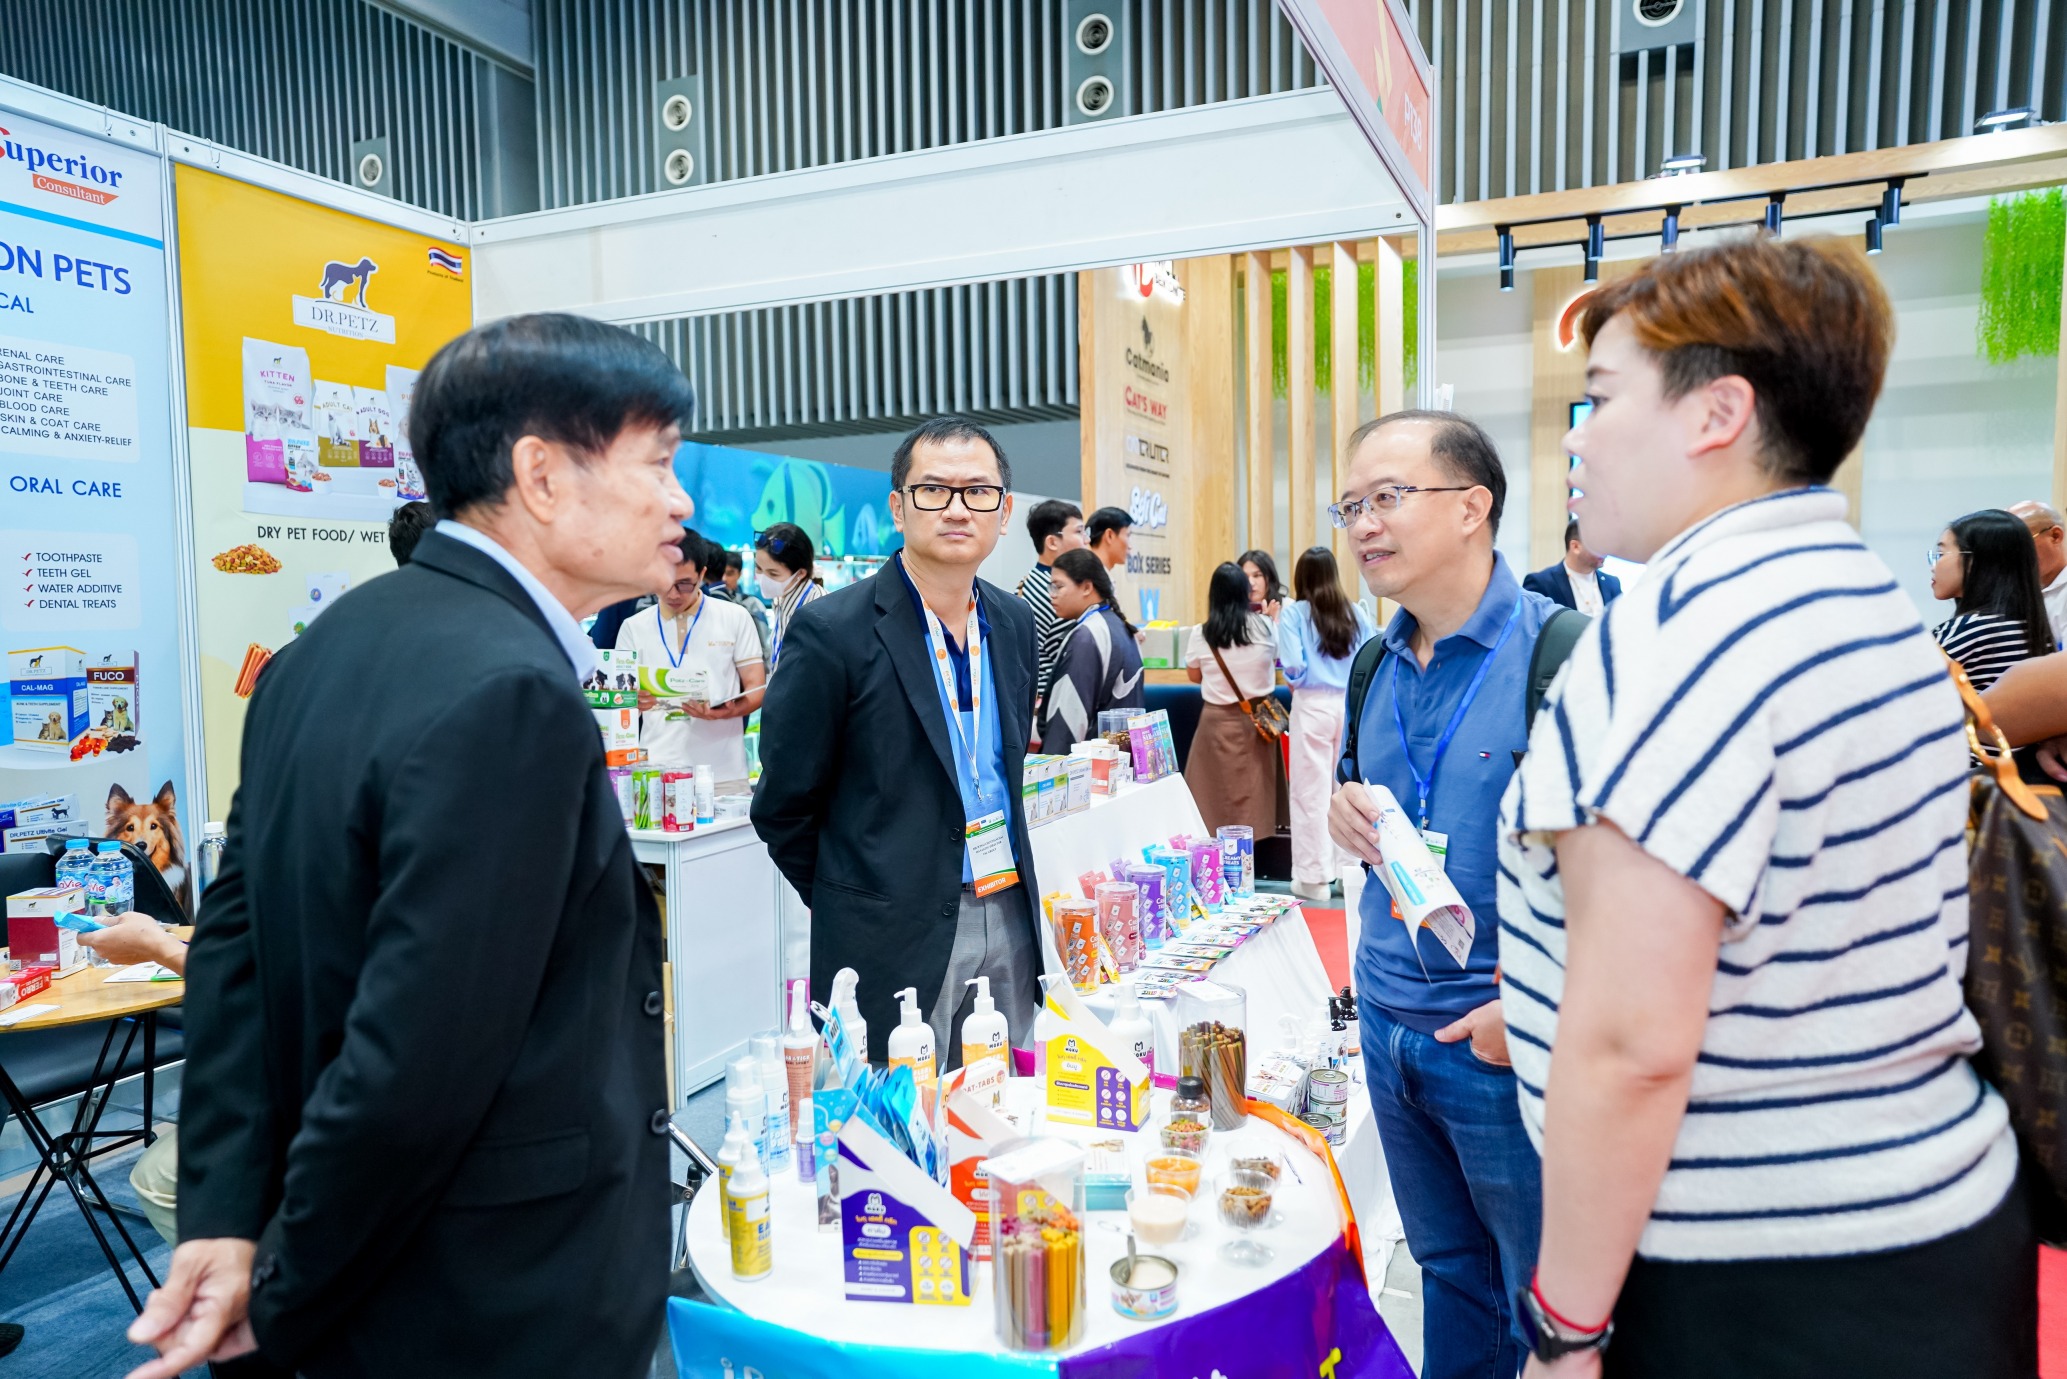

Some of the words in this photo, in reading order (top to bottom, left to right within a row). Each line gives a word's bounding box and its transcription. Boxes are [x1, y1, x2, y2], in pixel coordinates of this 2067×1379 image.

[36, 176, 106, 205] Consultant
[54, 253, 132, 295] PETS
[311, 306, 379, 334] DR.PETZ
[35, 353, 65, 365] CARE
[1126, 347, 1169, 383] Catmania
[105, 376, 132, 387] CARE
[260, 370, 295, 382] KITTEN
[32, 378, 39, 387] &
[43, 379, 77, 392] TEETH
[80, 384, 108, 396] CARE
[33, 391, 63, 402] CARE
[0, 400, 37, 412] BLOOD
[41, 405, 70, 416] CARE
[0, 413, 26, 424] SKIN
[30, 416, 37, 425] &
[40, 418, 70, 429] COAT
[73, 421, 102, 432] CARE
[1, 425, 50, 438] CALMING
[54, 431, 61, 440] &
[64, 432, 132, 447] ANXIETY-RELIEF
[10, 476, 63, 494] ORAL
[72, 480, 122, 498] CARE
[257, 525, 281, 539] DRY
[287, 527, 307, 541] PET
[312, 528, 355, 543] FOOD/
[360, 531, 386, 543] WET
[36, 552, 103, 563] TOOTHPASTE
[1146, 555, 1171, 575] SERIES
[37, 568, 67, 578] TEETH
[70, 568, 92, 578] GEL
[38, 584, 74, 593] WATER
[77, 584, 122, 594] ADDITIVE
[39, 599, 79, 609] DENTAL
[83, 599, 117, 609] TREATS
[93, 671, 125, 681] FUCO
[21, 684, 54, 692] CAL-MAG
[977, 877, 1006, 893] EXHIBITOR
[963, 1076, 996, 1094] AT-TABS
